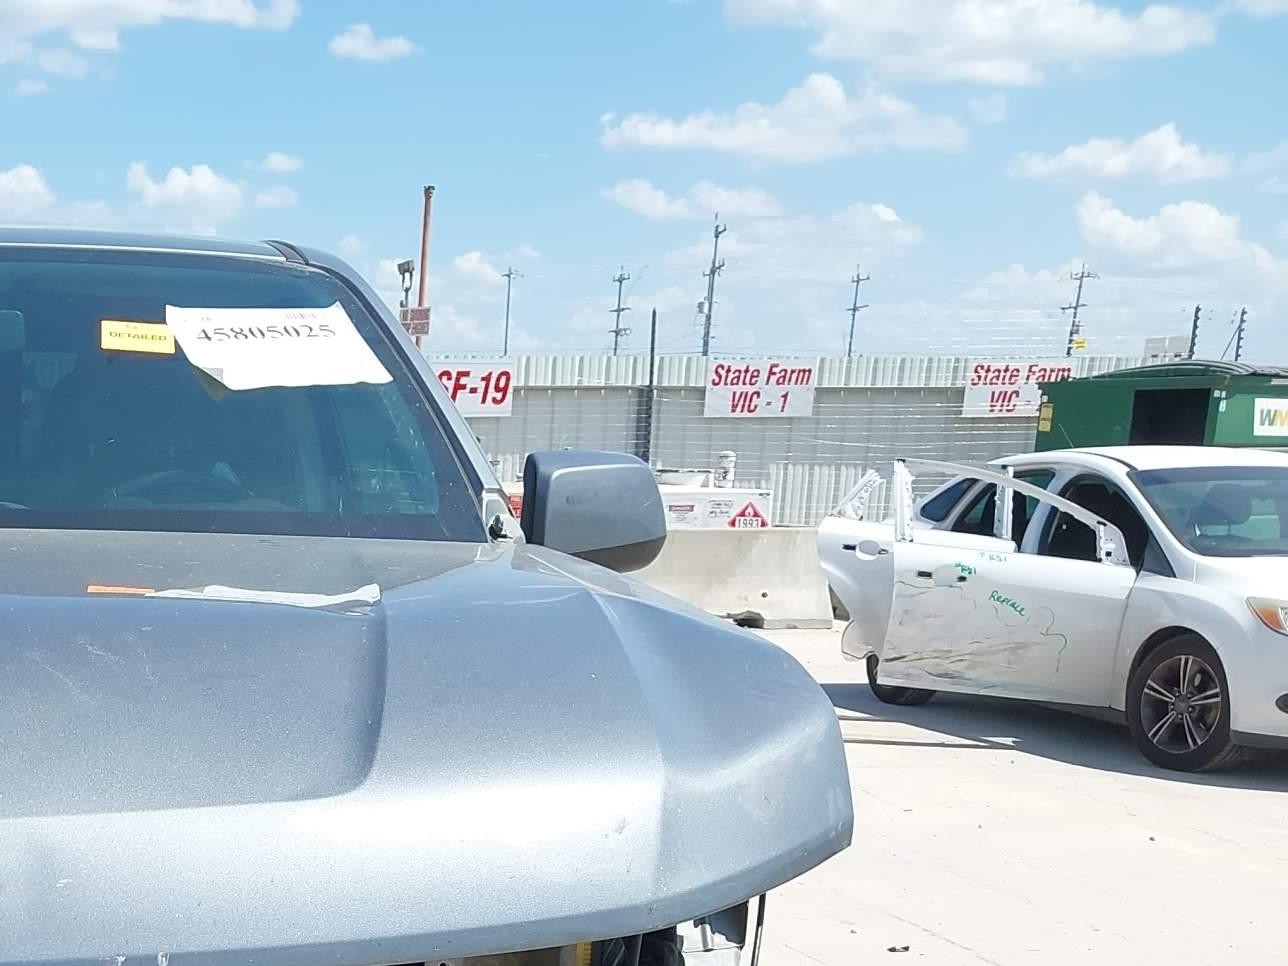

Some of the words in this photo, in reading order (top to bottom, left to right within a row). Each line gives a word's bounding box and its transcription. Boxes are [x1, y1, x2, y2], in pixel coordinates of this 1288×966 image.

[109, 330, 167, 342] DETAILED
[196, 324, 337, 343] 45805025
[711, 363, 761, 386] State
[765, 363, 813, 386] Farm
[970, 364, 1021, 386] State
[730, 390, 761, 414] VIC
[780, 390, 790, 413] 1
[989, 390, 1020, 413] VIC
